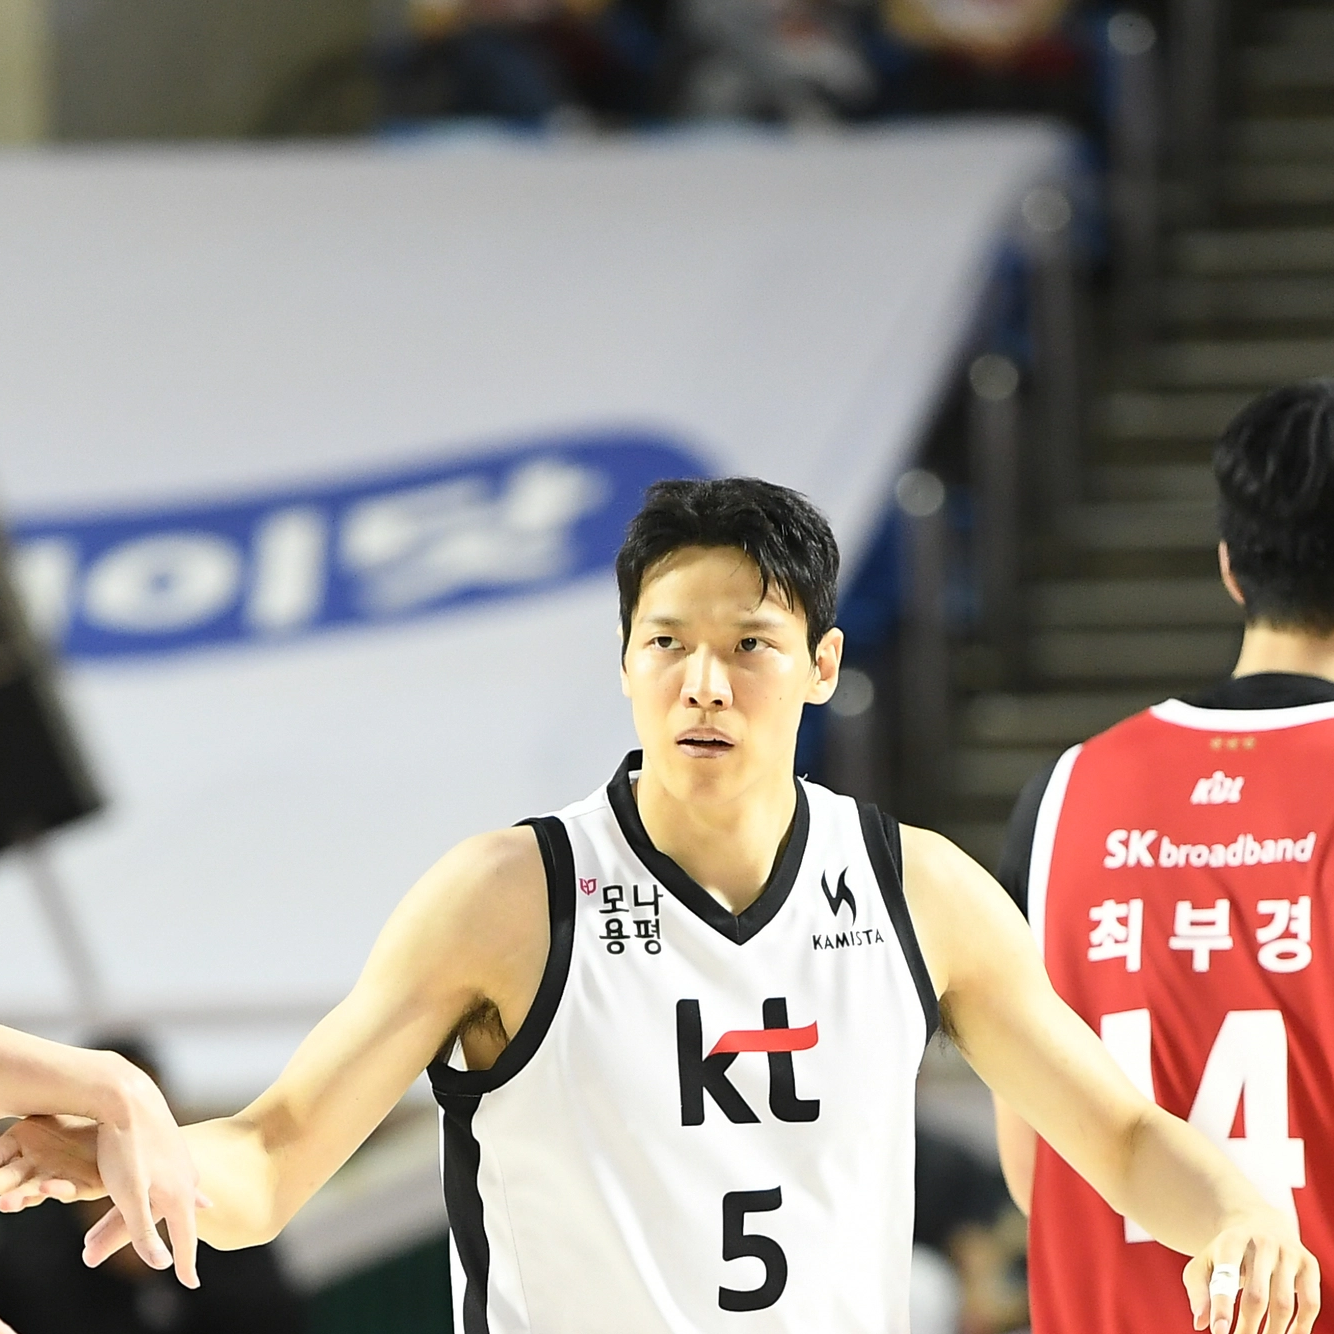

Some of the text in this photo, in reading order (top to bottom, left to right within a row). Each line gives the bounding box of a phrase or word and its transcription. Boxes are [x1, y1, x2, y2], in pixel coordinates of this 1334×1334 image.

[1103, 829, 1317, 869] SK broadband
[599, 884, 664, 917] 모나
[599, 918, 663, 955] 용평
[812, 929, 884, 952] KAMISTA
[676, 997, 820, 1126] kt
[1101, 1008, 1305, 1245] 14
[718, 1186, 788, 1312] 5
